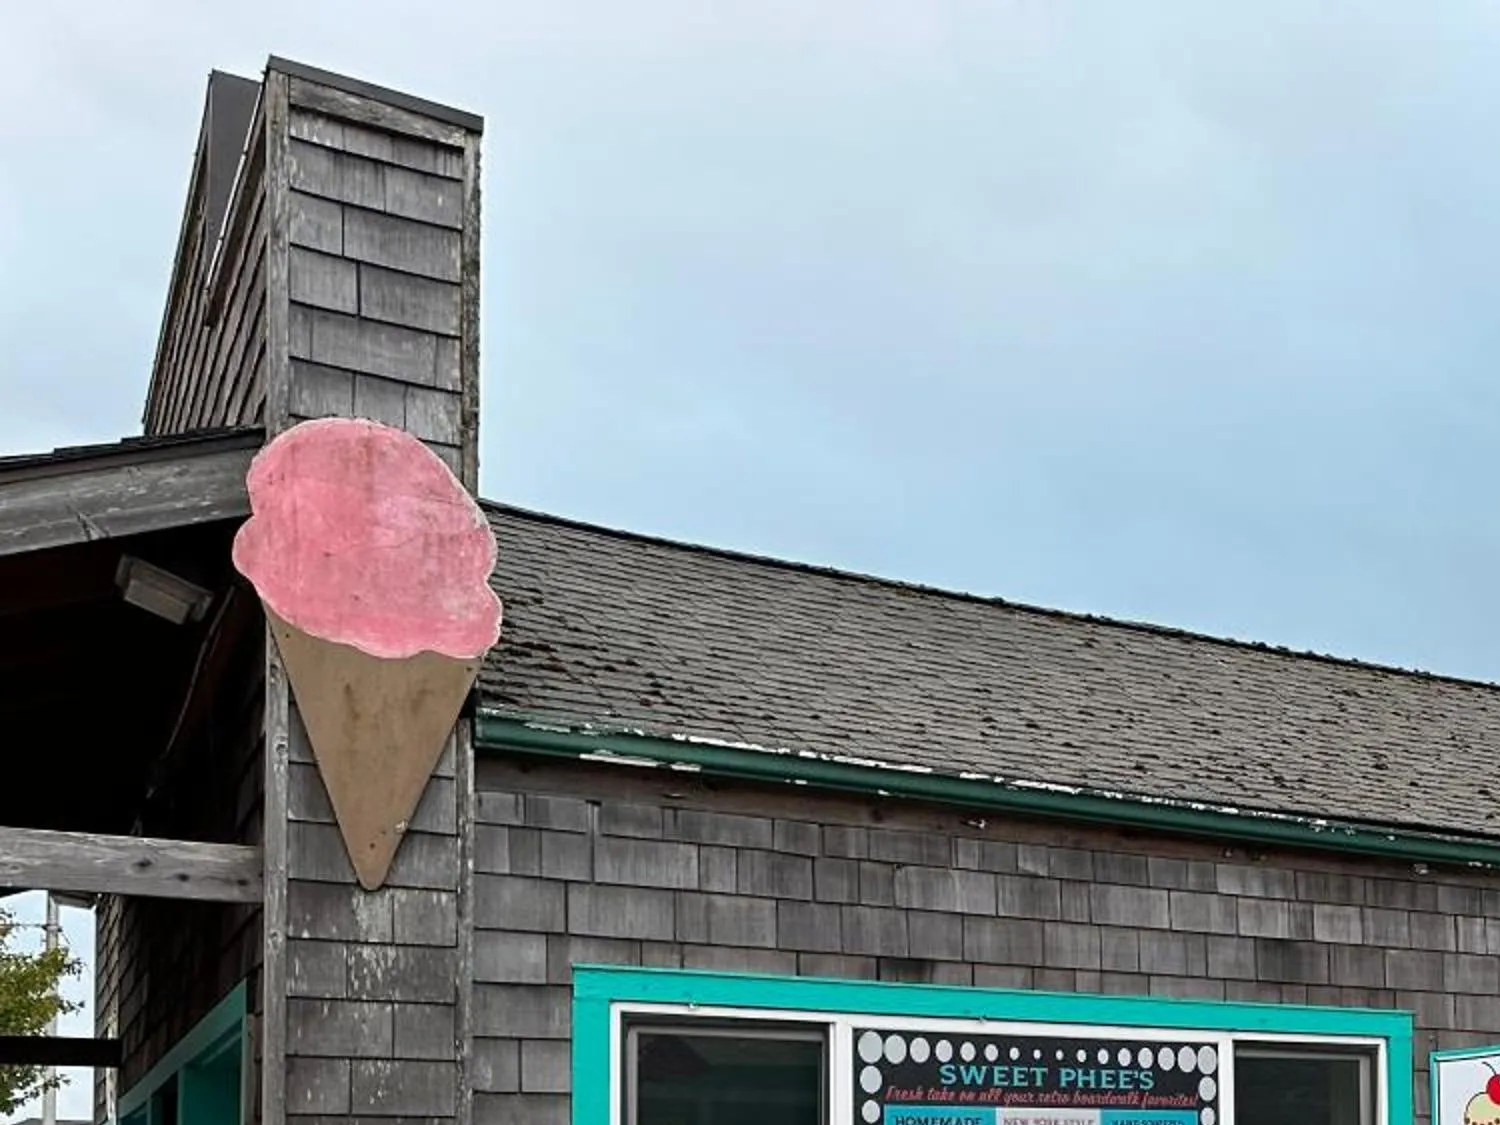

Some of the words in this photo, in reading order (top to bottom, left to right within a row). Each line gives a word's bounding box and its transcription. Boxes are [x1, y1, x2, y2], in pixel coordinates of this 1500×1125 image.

[939, 1063, 1048, 1087] SWEET
[1059, 1067, 1155, 1090] PHEE'S
[885, 1085, 923, 1101] Fresh
[926, 1087, 955, 1101] take
[1003, 1090, 1035, 1106] your
